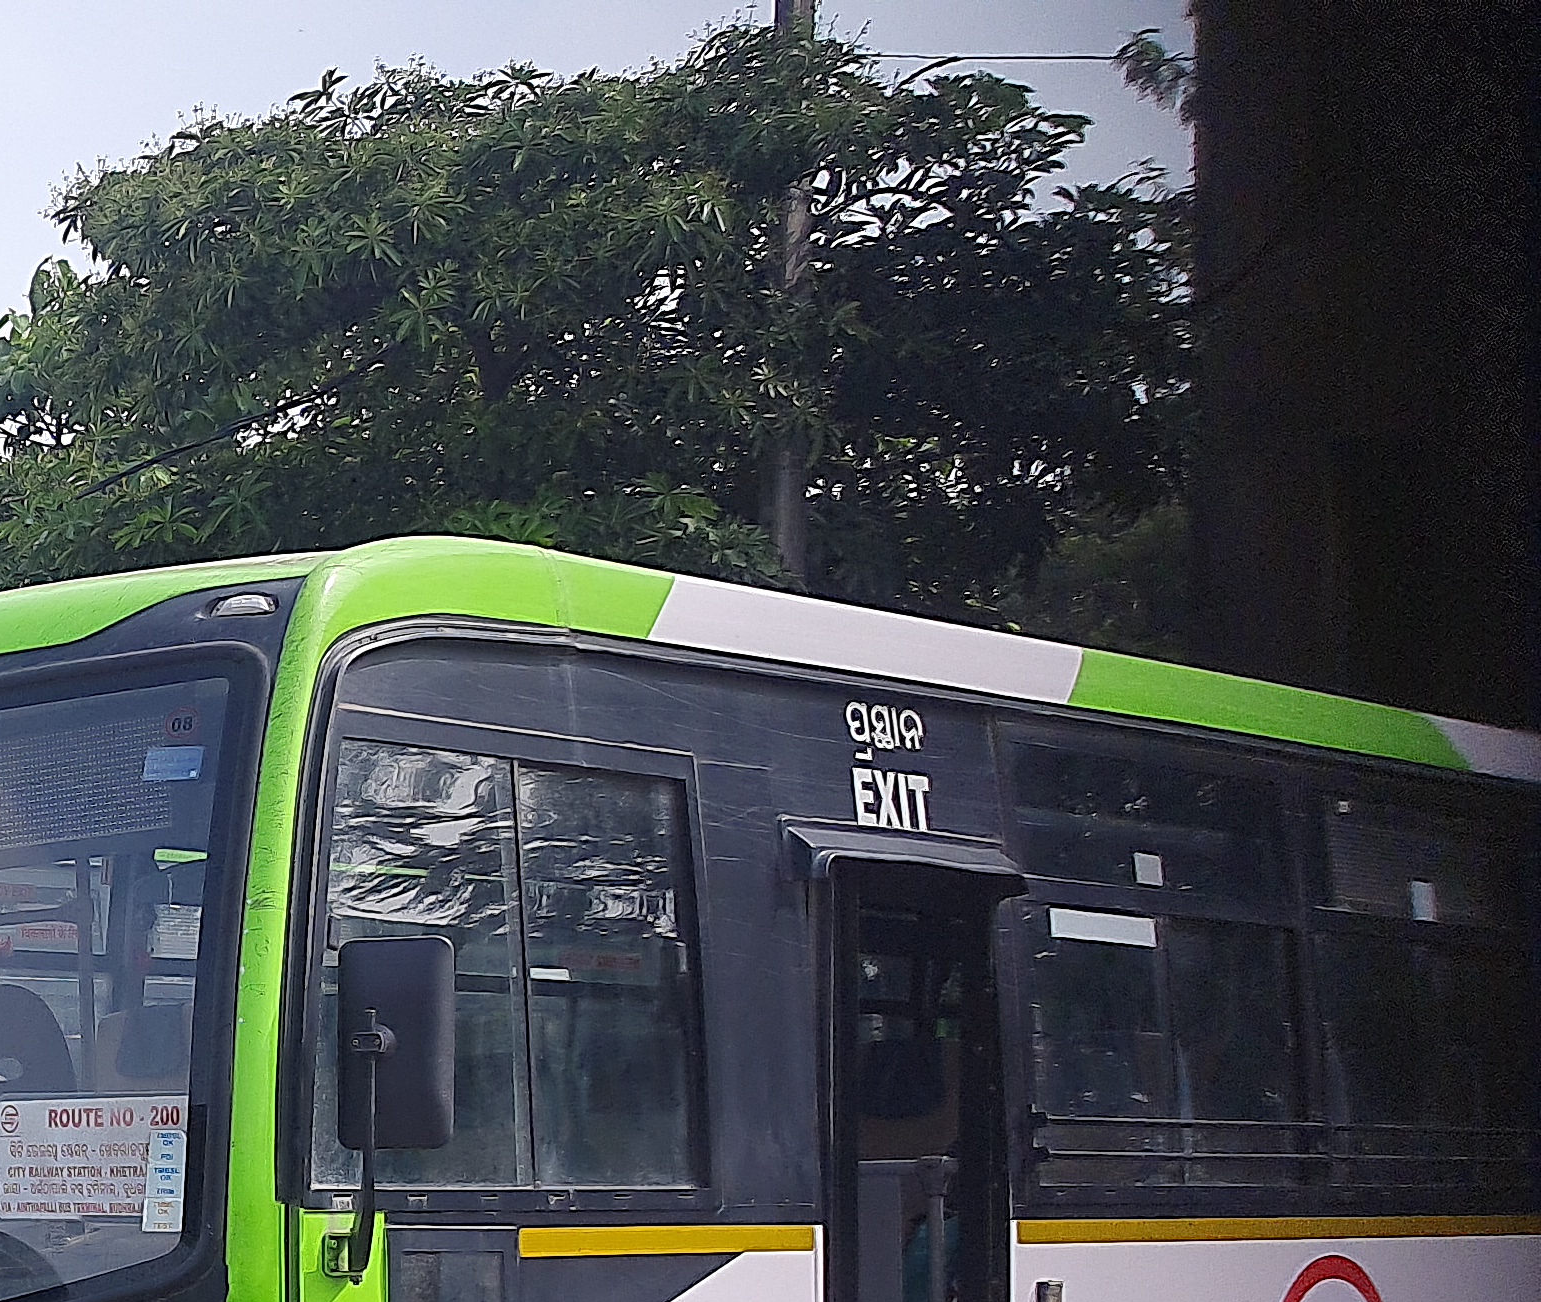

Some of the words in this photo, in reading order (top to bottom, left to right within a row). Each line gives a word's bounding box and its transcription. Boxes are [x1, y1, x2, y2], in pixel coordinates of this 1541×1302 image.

[851, 766, 930, 831] EXIT
[47, 1107, 104, 1129] ROUTE
[109, 1107, 134, 1127] NO
[149, 1105, 181, 1127] 200
[7, 1166, 27, 1178] CITY
[28, 1165, 65, 1178] RAILWAY
[66, 1165, 103, 1178] STATION
[109, 1165, 147, 1178] KHETRA
